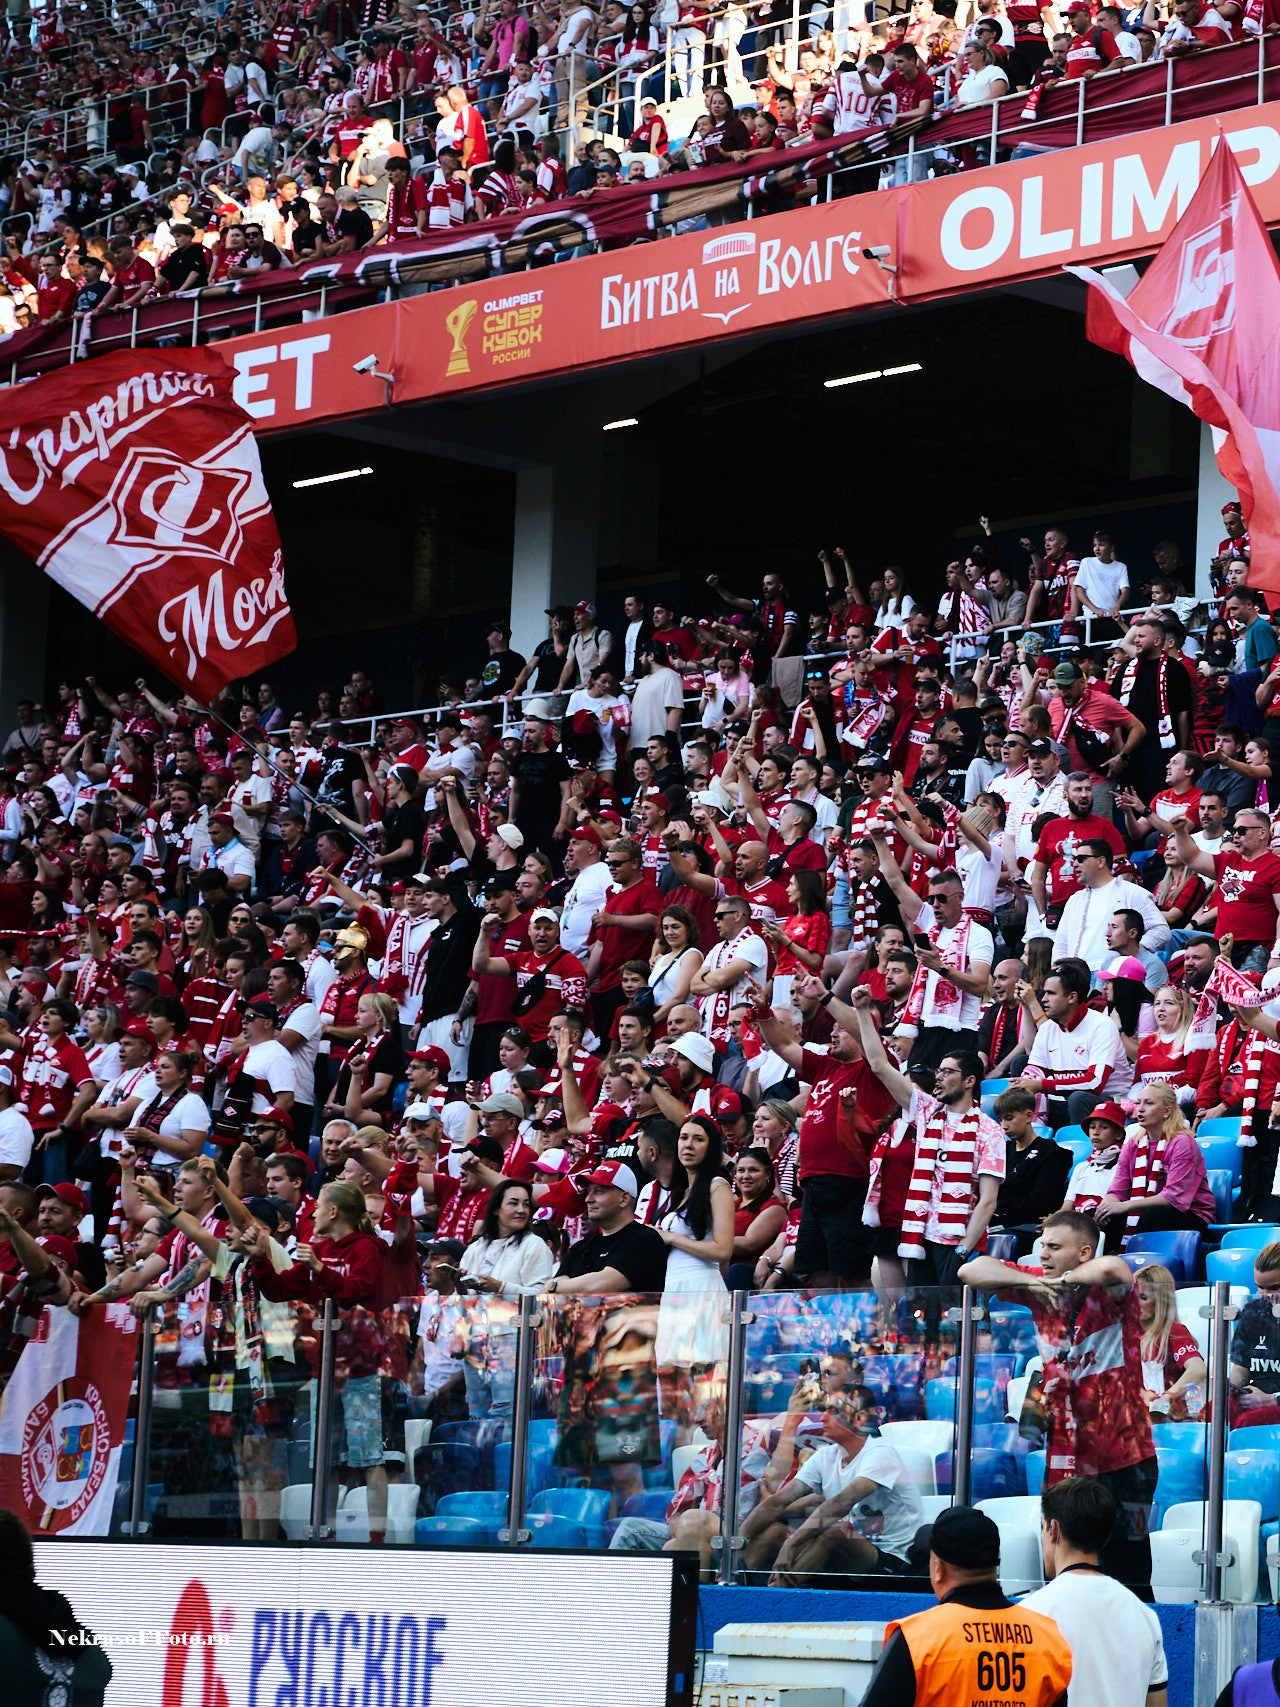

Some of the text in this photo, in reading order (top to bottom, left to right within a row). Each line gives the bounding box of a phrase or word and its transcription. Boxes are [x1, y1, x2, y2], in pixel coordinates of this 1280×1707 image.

[846, 91, 869, 114] 10
[714, 266, 740, 298] на
[484, 290, 544, 312] OLIMPBET
[483, 304, 543, 334] СУПЕР
[482, 323, 543, 354] КУБОК
[493, 348, 531, 365] РОССИИ
[71, 1383, 111, 1522] КРАСНО-БЕЛАЯ
[962, 1623, 1033, 1645] STEWARD
[977, 1651, 1026, 1692] 605
